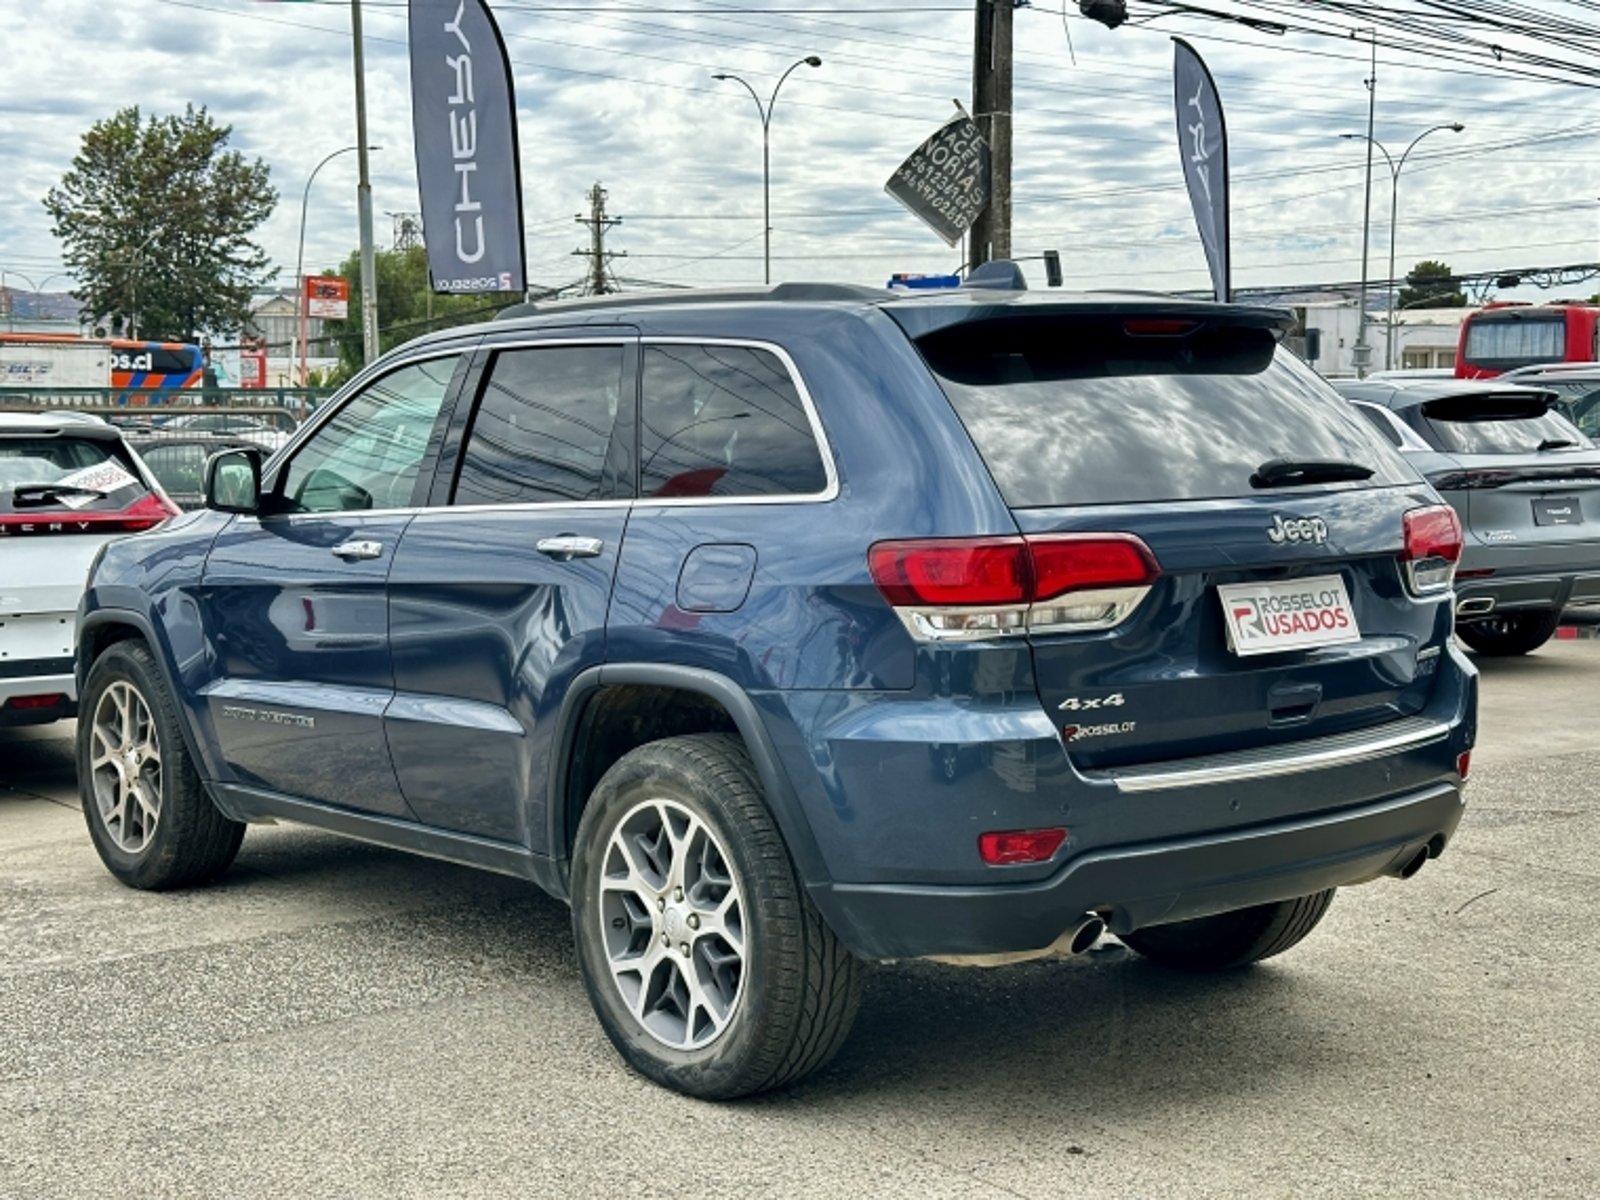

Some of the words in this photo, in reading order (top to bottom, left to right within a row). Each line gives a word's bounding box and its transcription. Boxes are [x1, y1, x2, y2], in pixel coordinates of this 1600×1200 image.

[1267, 514, 1328, 545] Jeep
[1259, 589, 1341, 614] ROSSELOT
[1265, 607, 1350, 636] USADOS
[1058, 692, 1125, 710] 4x4
[1080, 721, 1136, 738] ROSSELOT
